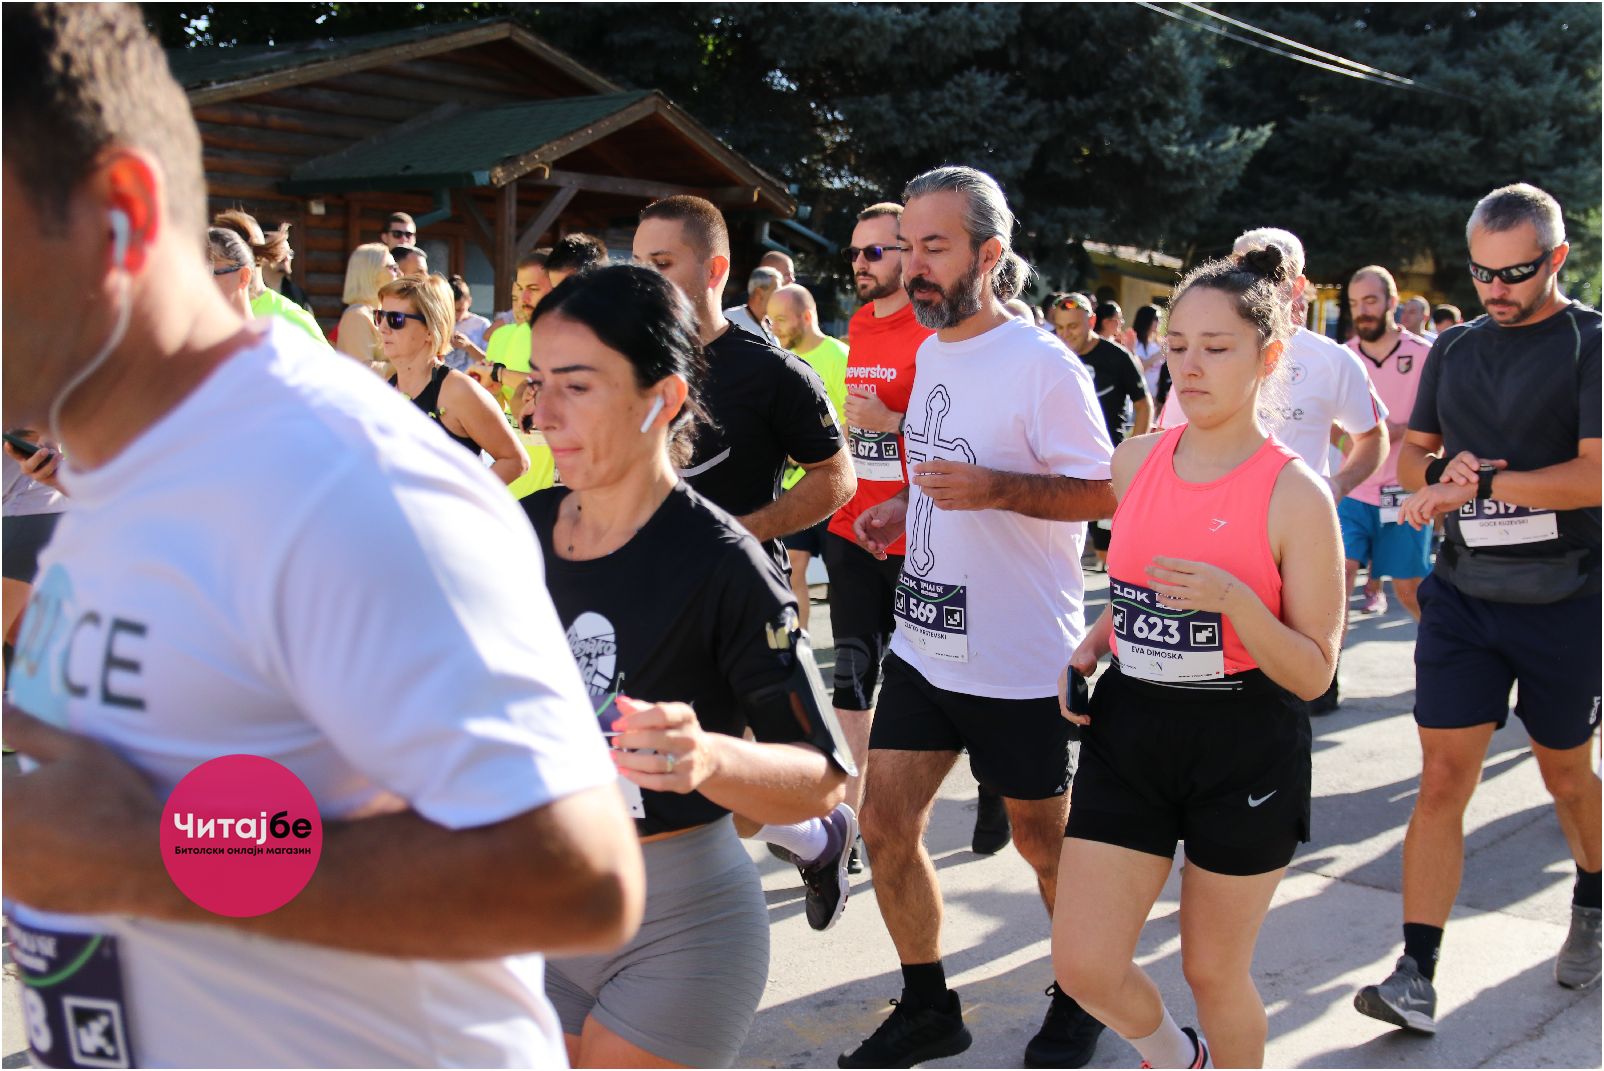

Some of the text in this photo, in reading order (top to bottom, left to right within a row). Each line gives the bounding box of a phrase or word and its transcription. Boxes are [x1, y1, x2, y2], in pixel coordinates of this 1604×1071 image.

[858, 441, 878, 457] 672
[1113, 584, 1151, 603] 10K
[909, 597, 937, 624] 569
[1133, 614, 1181, 645] 623
[1131, 646, 1184, 660] EVA DIMOSKA
